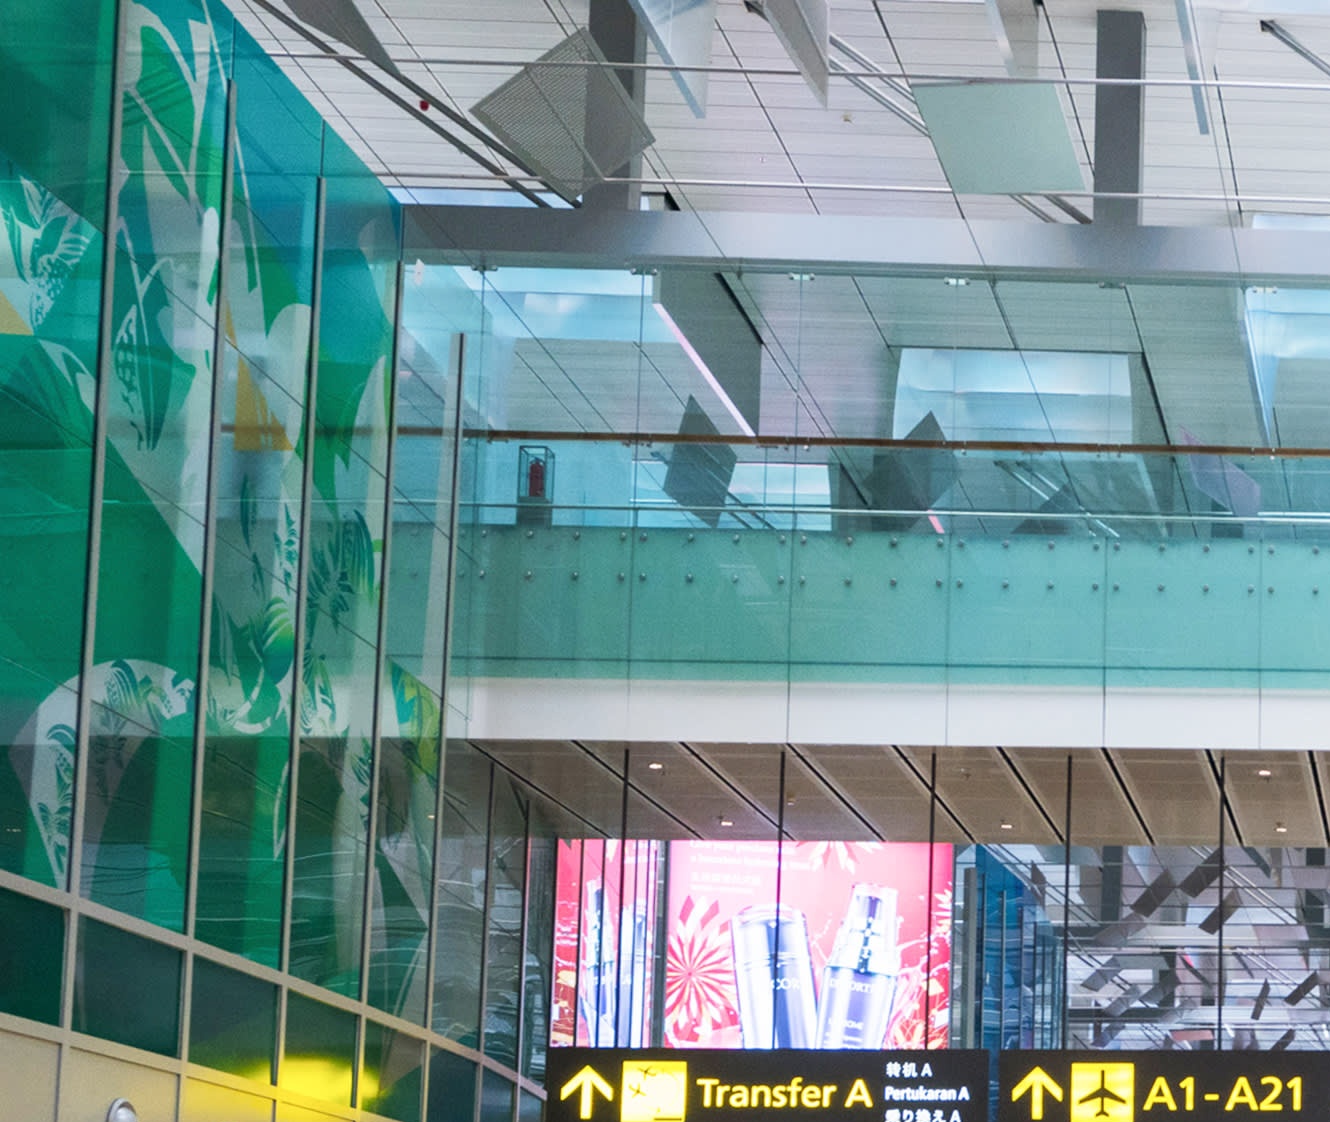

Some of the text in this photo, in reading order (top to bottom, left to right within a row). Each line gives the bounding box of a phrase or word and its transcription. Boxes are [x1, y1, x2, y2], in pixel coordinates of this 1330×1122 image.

[920, 1062, 933, 1078] A
[697, 1077, 874, 1109] Transfer A
[884, 1085, 971, 1101] Pertukaran A
